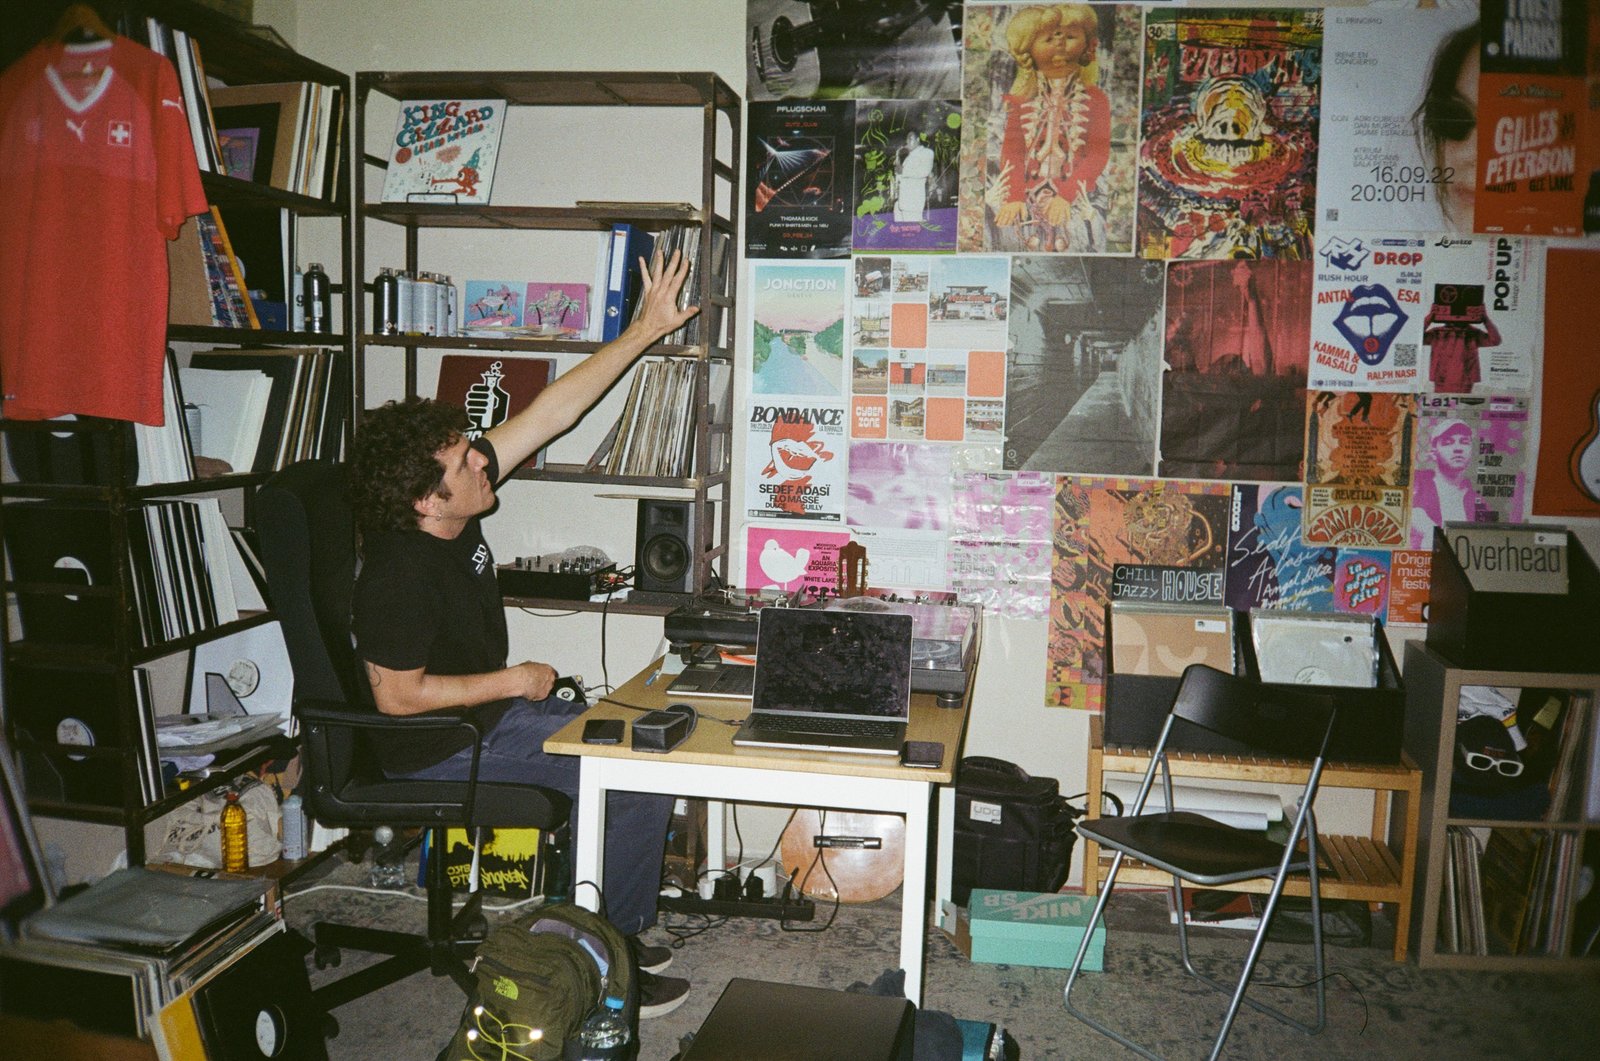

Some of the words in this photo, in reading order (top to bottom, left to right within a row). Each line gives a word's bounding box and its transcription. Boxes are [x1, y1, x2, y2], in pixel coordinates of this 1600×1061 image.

[402, 101, 462, 129] KING
[396, 106, 494, 148] GIZZARD
[1494, 109, 1558, 154] GILLES
[1485, 145, 1576, 186] PETERSON
[1370, 166, 1455, 184] 16.09.22
[1351, 184, 1425, 202] 20:00H
[1373, 251, 1423, 267] DROP
[1496, 238, 1513, 266] UP
[764, 278, 837, 291] JONCTION
[1318, 274, 1341, 282] RUSH
[1344, 274, 1368, 282] HOUR
[1317, 288, 1354, 304] ANTAL
[1397, 288, 1421, 304] ESA
[1494, 269, 1510, 311] POP
[1313, 340, 1350, 361] KAMMA
[1351, 352, 1360, 364] &
[1316, 353, 1358, 375] MASALO
[1367, 371, 1393, 381] RALPH
[750, 406, 844, 425] BONDANCE
[855, 406, 884, 417] CYBER
[858, 417, 881, 428] ZONE
[759, 484, 794, 494] SEDEF
[1311, 506, 1355, 542] SANT
[1354, 506, 1401, 542] JOAN
[1454, 535, 1560, 574] Overhead
[1115, 566, 1158, 582] CHILL
[1402, 577, 1431, 589] festiv
[1113, 583, 1160, 598] JAZZY
[1161, 570, 1223, 601] HOUSE
[983, 893, 1017, 908] SB
[1011, 901, 1082, 921] NIKE
